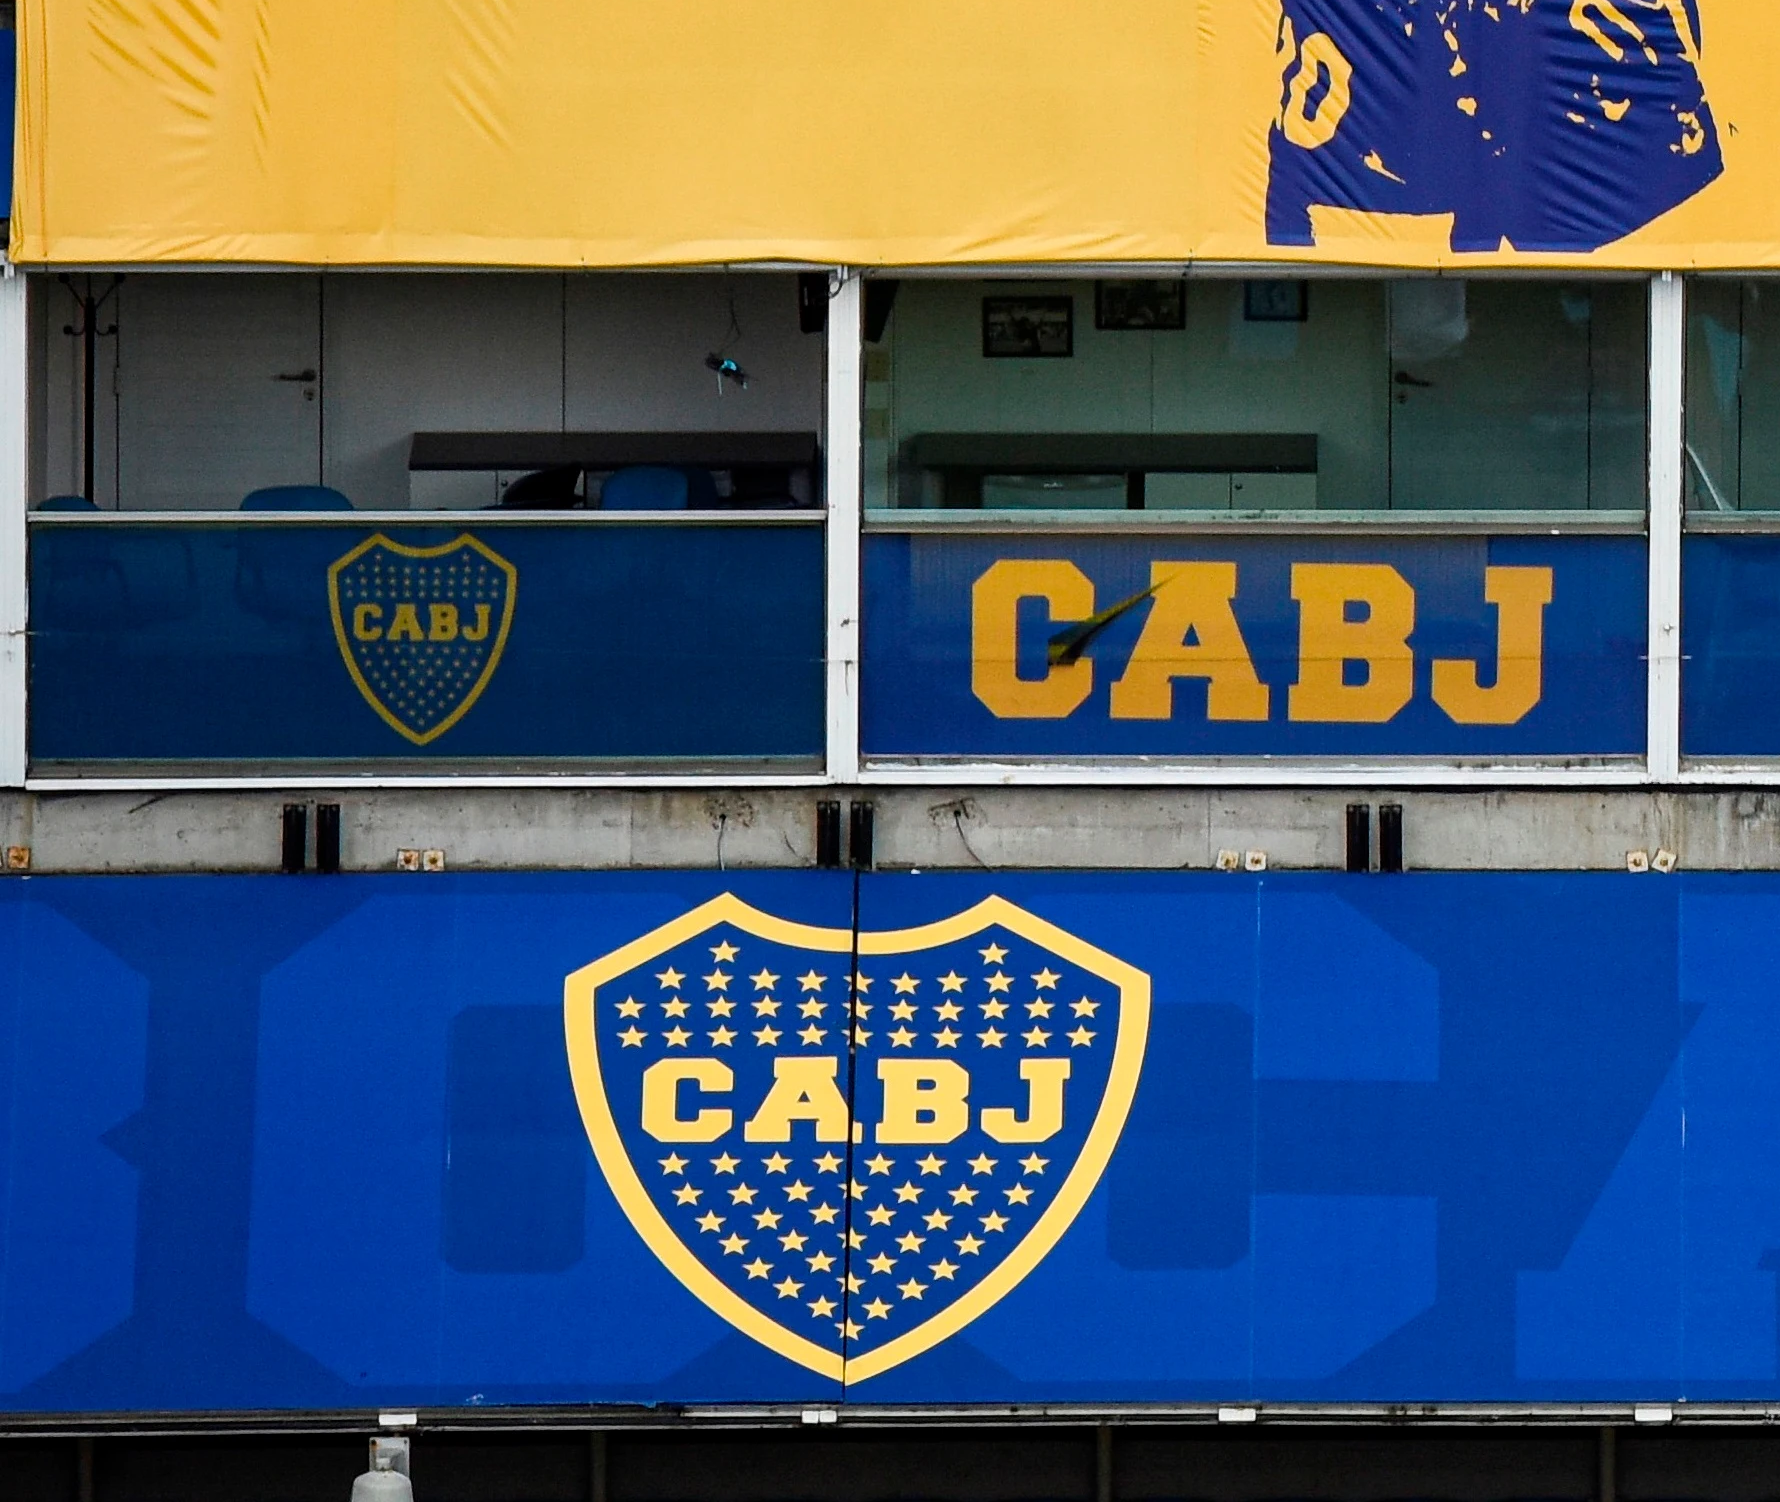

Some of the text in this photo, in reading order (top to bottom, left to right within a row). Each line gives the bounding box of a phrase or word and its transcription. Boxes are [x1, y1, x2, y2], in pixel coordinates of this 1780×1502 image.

[354, 603, 491, 643] CABJ
[972, 559, 1553, 724] CABJ
[644, 1058, 1070, 1143] CABJ
